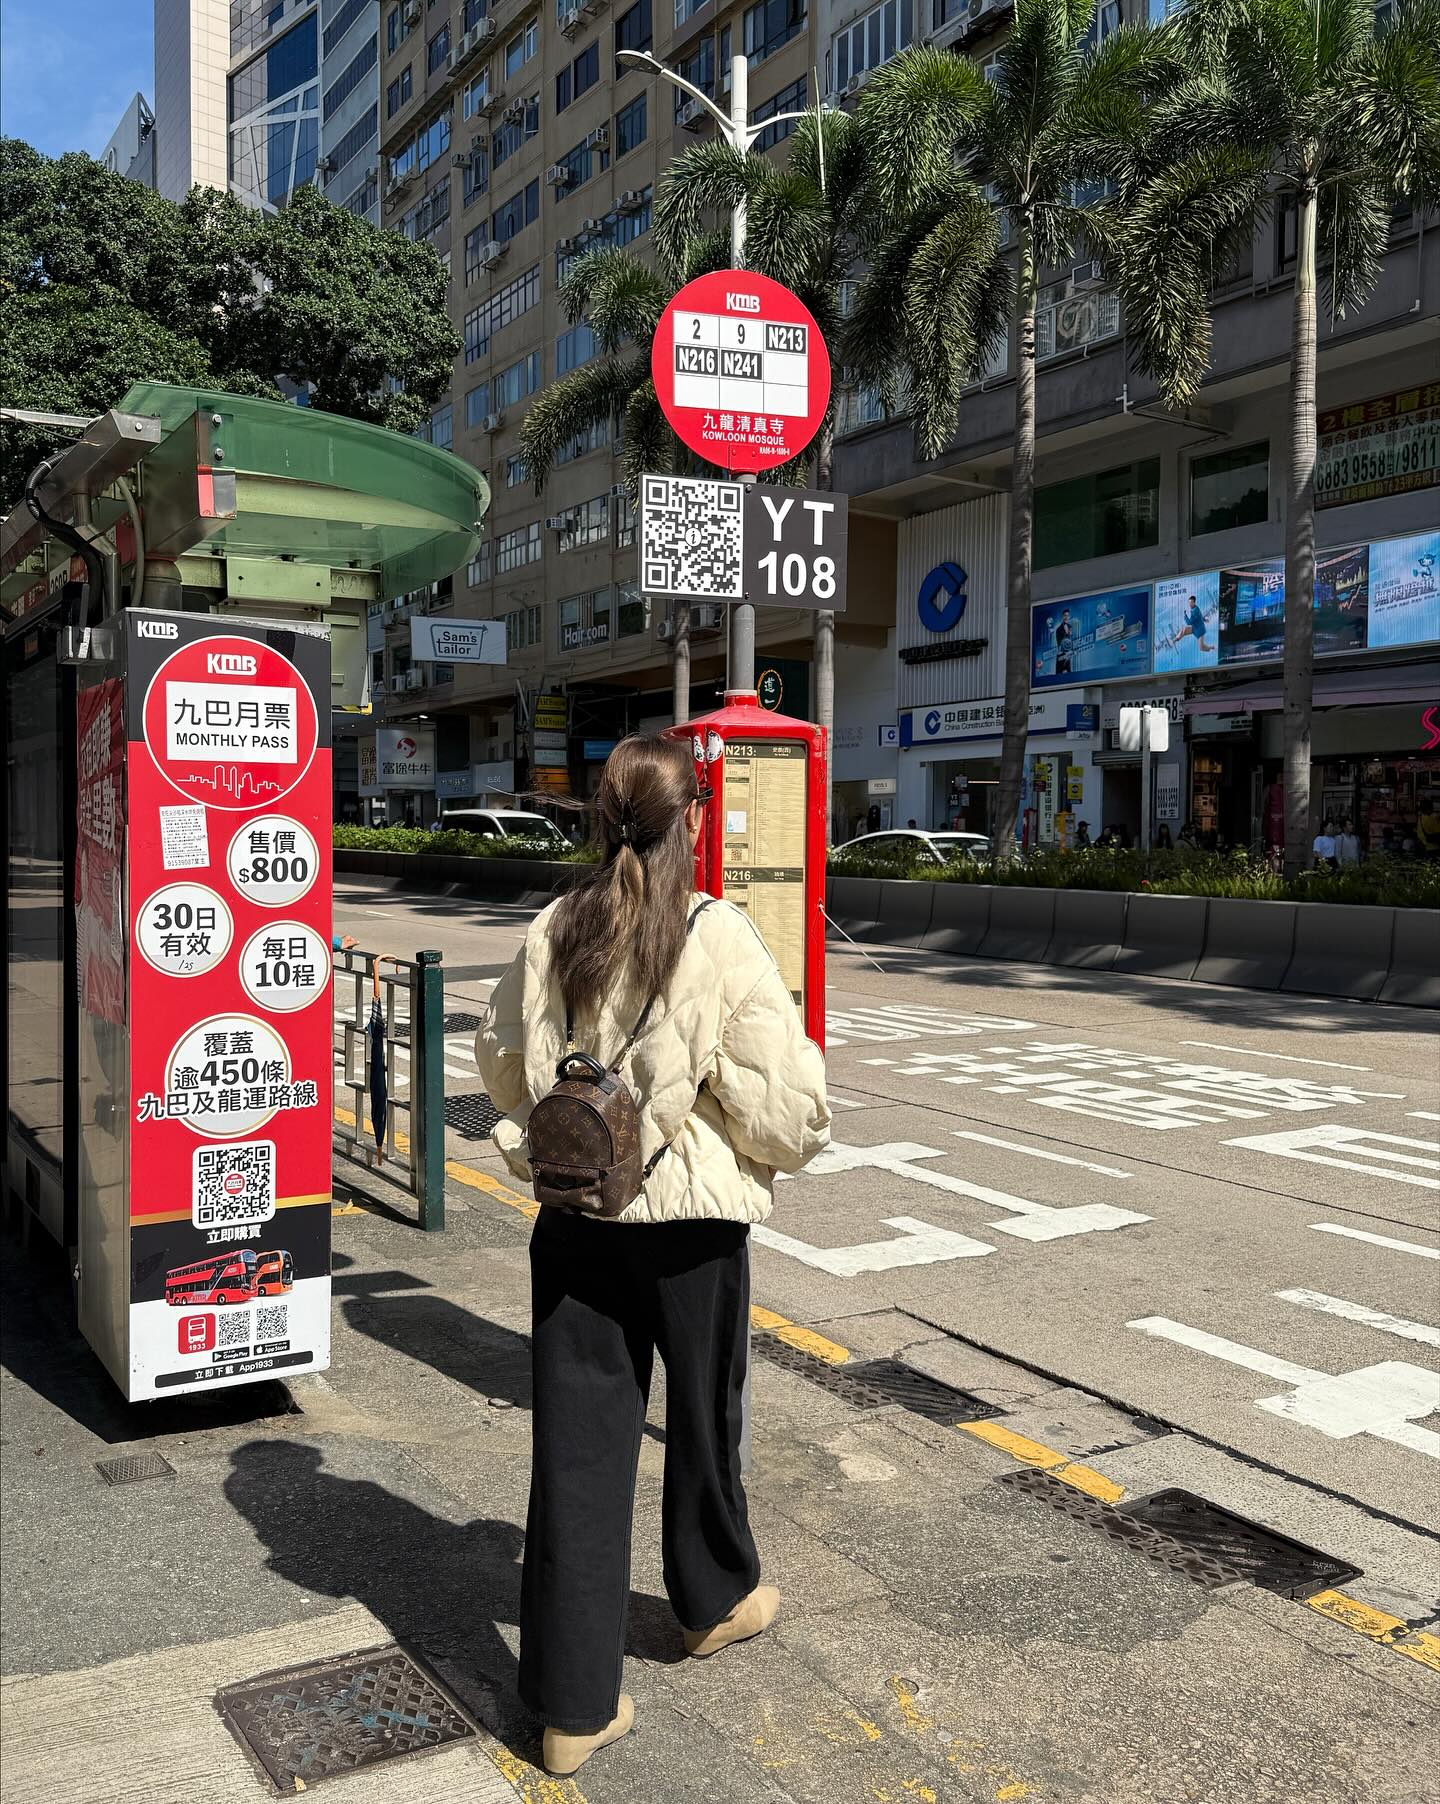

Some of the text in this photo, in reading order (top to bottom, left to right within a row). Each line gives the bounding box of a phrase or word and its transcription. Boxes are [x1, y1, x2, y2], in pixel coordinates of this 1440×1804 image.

[726, 292, 760, 312] KMB
[692, 318, 804, 351] 2 9 N213
[678, 348, 758, 377] N216 N241
[702, 412, 784, 435] 九龍清真寺
[702, 430, 785, 446] KOWLOON MOSQUE
[758, 551, 836, 599] 108
[137, 620, 179, 640] KMB
[442, 631, 478, 643] Sam's
[207, 653, 257, 676] KMB
[173, 697, 291, 730] 九巴月票
[176, 733, 289, 749] MONTHLY PASS
[725, 745, 757, 757] N213:
[248, 830, 296, 855] 售價
[238, 857, 308, 884] $800
[723, 869, 754, 881] N216:
[152, 903, 216, 931] 30日
[160, 931, 212, 957] 有效
[262, 936, 307, 961] 每日
[255, 960, 315, 988] 10程
[203, 1031, 254, 1057] 覆蓋
[174, 1057, 285, 1091] 逾450條
[139, 1081, 317, 1120] 九巴及龍運路線
[206, 1224, 262, 1244] 立即購買
[188, 1342, 206, 1351] 1933
[194, 1359, 274, 1380] 立即下載 App1933
